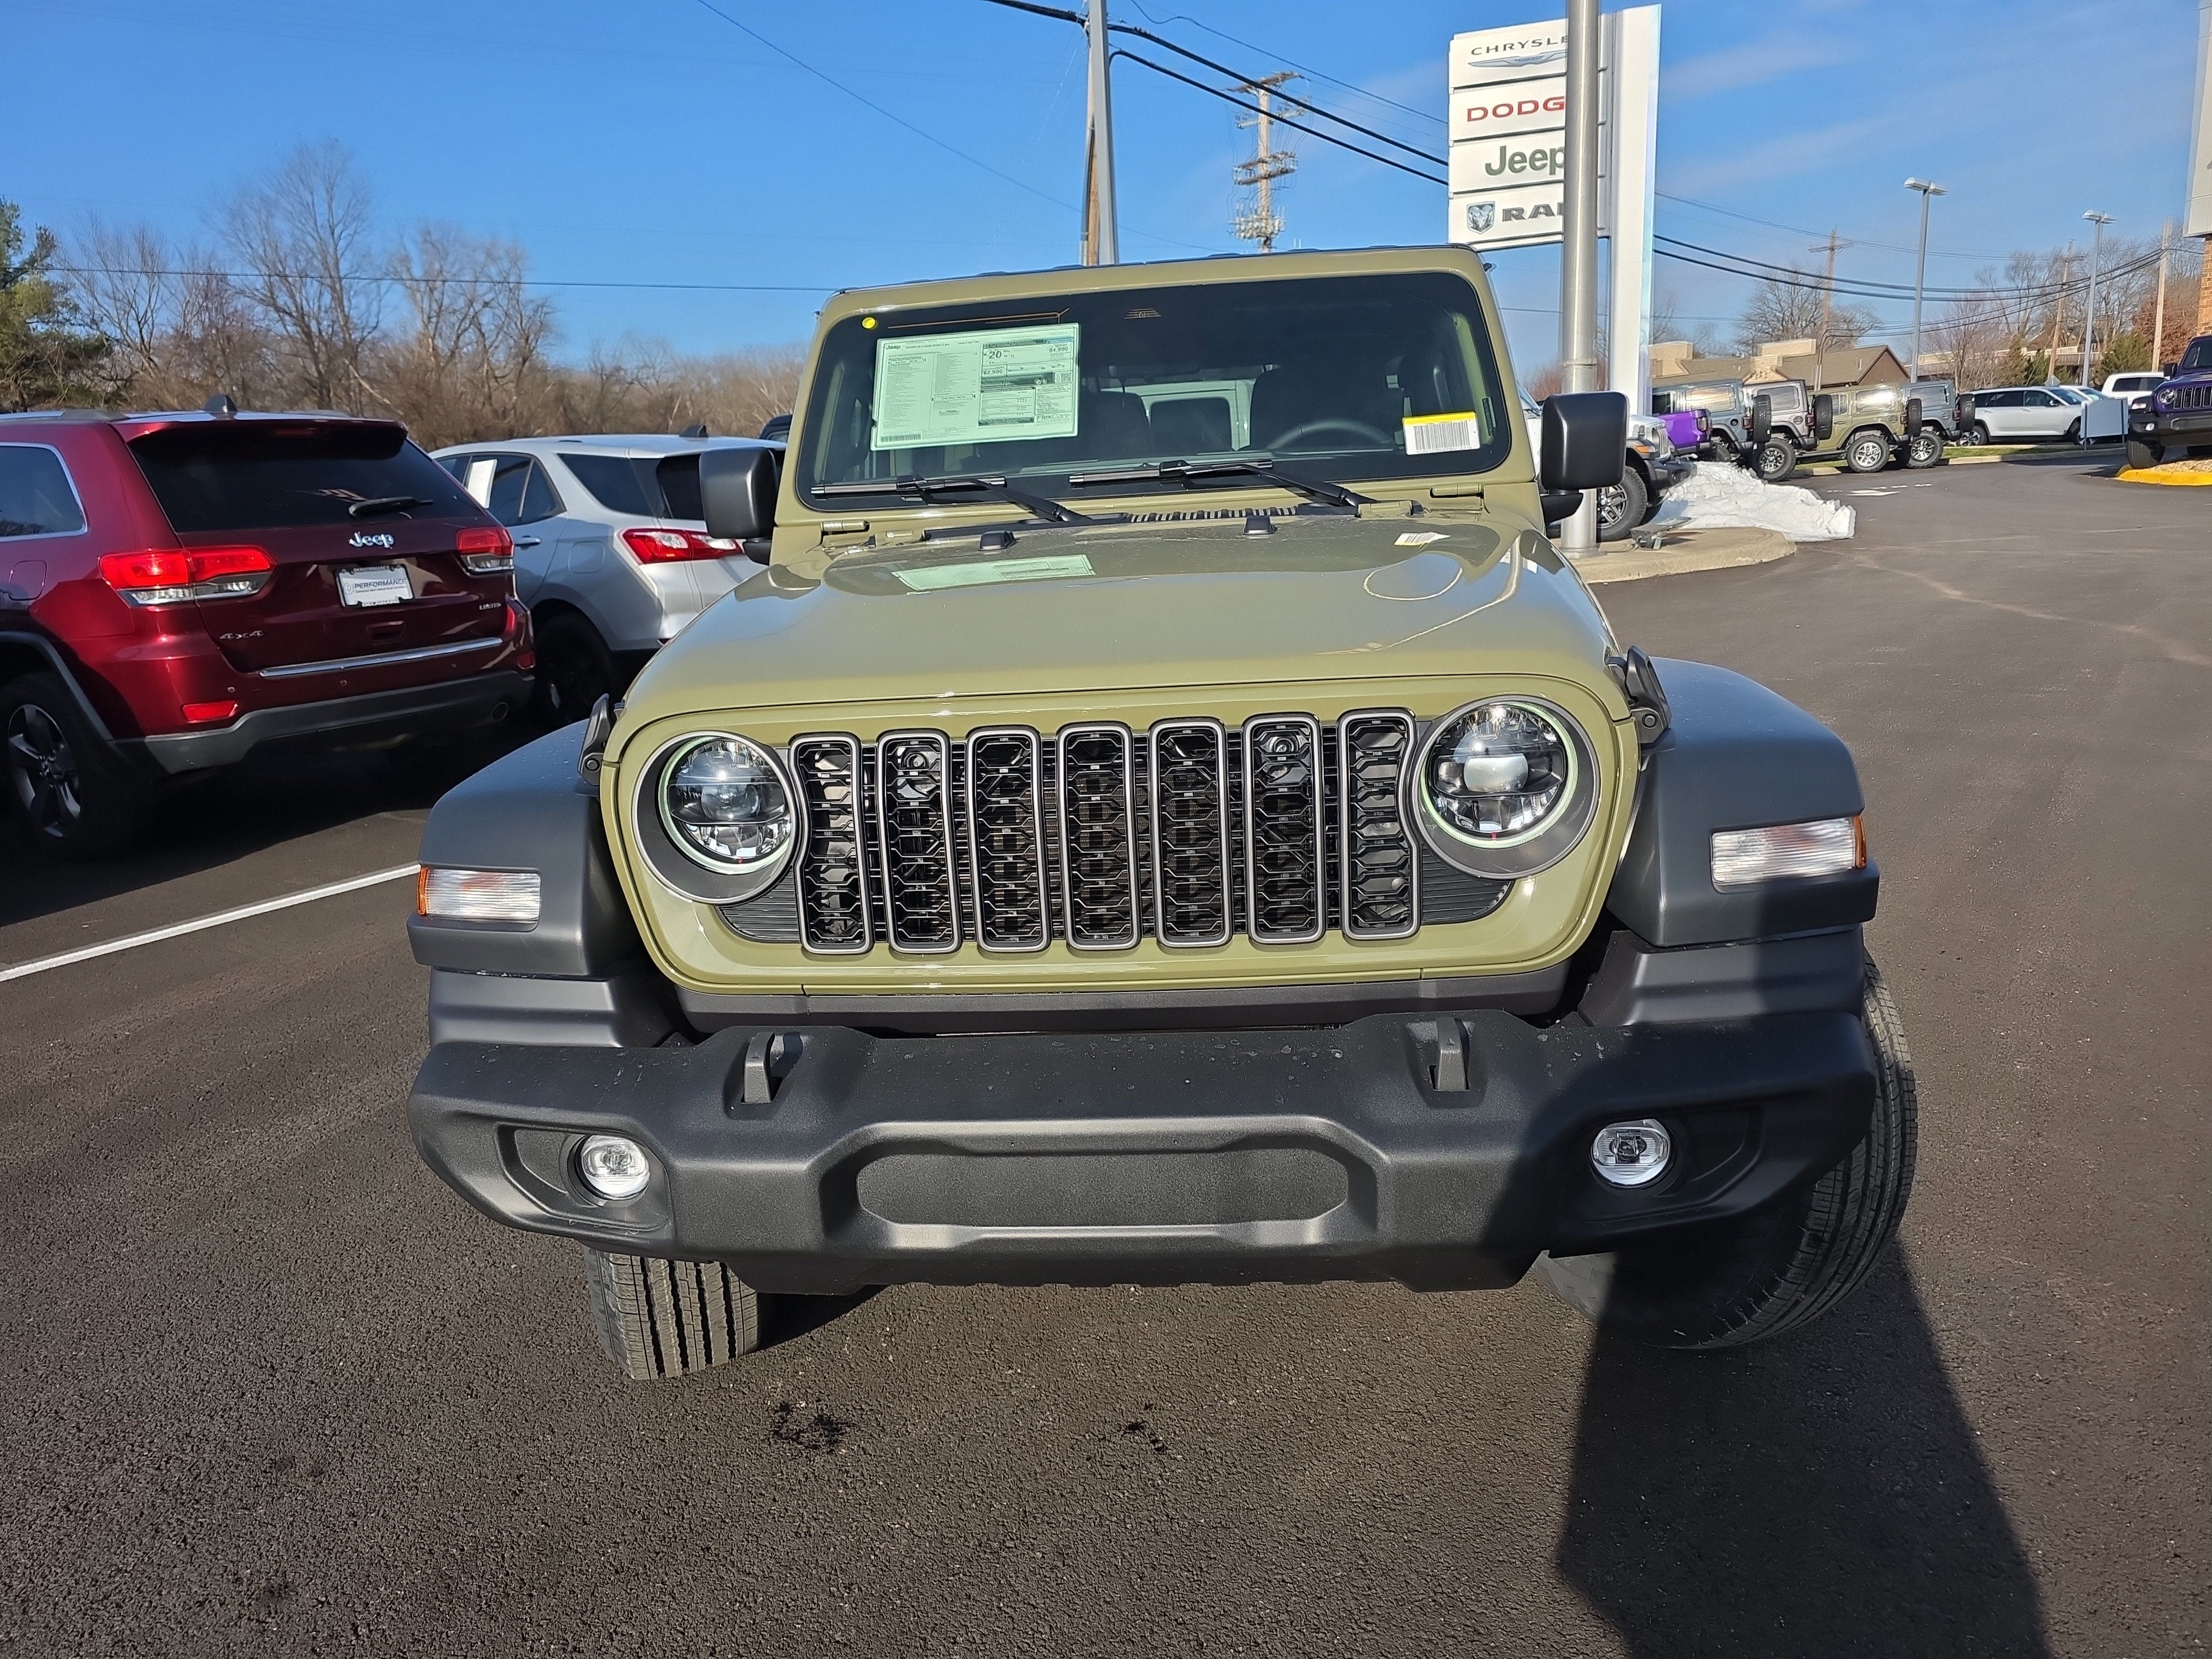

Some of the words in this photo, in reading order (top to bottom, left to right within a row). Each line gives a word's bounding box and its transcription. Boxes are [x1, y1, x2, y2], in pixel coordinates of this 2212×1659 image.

[1467, 95, 1565, 122] DODG
[1485, 145, 1565, 176] Jeep
[988, 350, 1002, 359] 20
[1036, 413, 1071, 421] FlexCare
[349, 531, 394, 548] Jeep
[354, 578, 407, 589] PERFORMANCE
